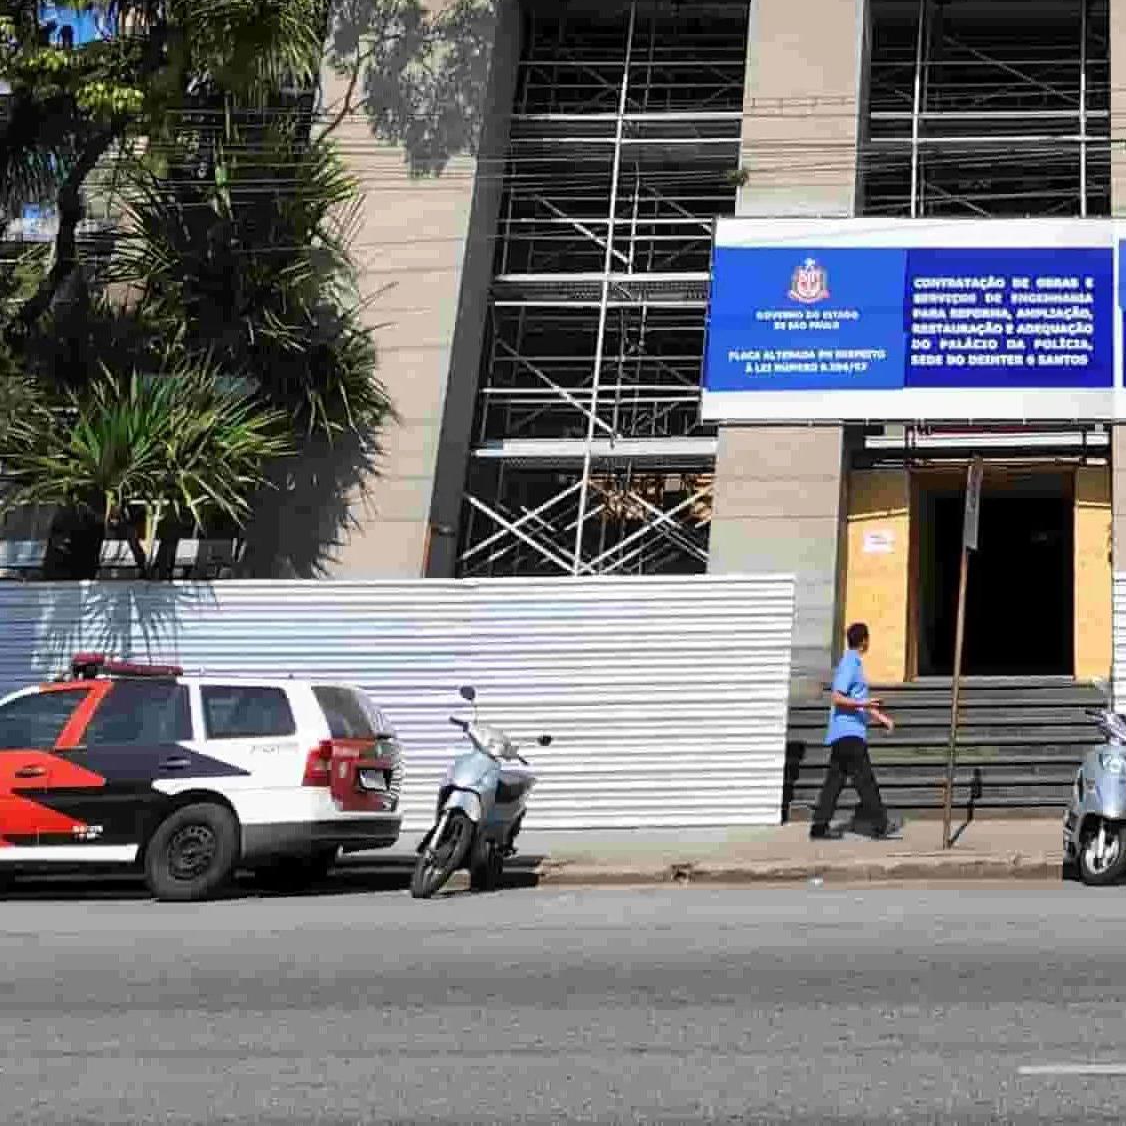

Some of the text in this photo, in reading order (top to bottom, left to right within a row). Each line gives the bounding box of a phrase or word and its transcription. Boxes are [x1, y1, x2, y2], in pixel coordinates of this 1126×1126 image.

[913, 276, 1094, 290] CONTRATAÇÃO DE OBRAS E
[913, 292, 1094, 305] SERVIÇOS DE ENGENHARIA
[755, 310, 859, 321] GOVERNO DO ESTADO
[912, 308, 947, 319] PARA
[912, 321, 1094, 335] RESTAURAÇÃO E ADEQUAÇÃO
[911, 338, 931, 349] DO
[940, 337, 998, 349] PALÁCIO
[1006, 339, 1025, 349] DA
[911, 354, 943, 365] SEDE
[946, 354, 965, 365] DO
[1038, 354, 1088, 365] SANTOS
